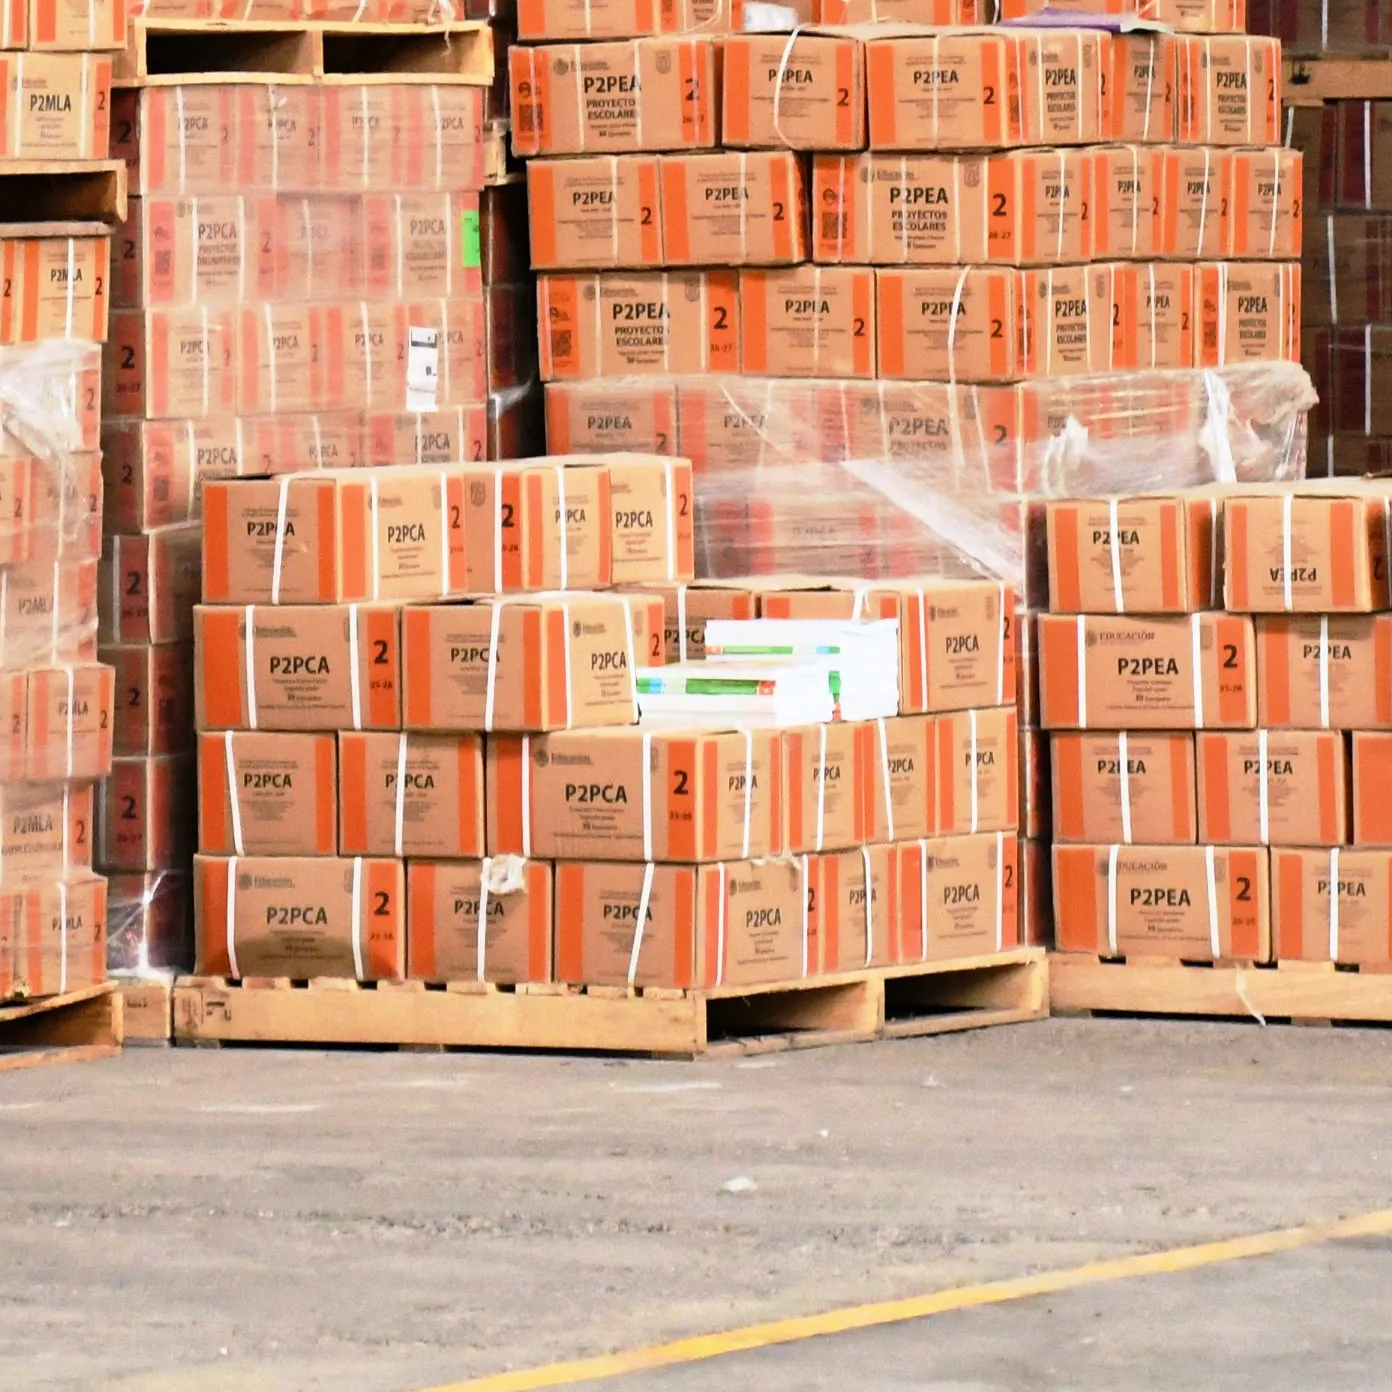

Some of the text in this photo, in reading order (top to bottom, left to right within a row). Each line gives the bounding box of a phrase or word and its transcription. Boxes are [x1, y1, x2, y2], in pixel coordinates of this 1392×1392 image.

[1045, 69, 1076, 85] P2PEA
[1217, 72, 1246, 89] P2PEA
[30, 94, 71, 111] P2MLA
[587, 99, 635, 108] PROYECTO
[838, 88, 849, 106] 2
[984, 86, 994, 104] 2
[588, 110, 635, 120] ESCOLARE
[117, 120, 131, 143] 2
[993, 194, 1007, 216] 2
[199, 223, 236, 239] P2PCA
[95, 277, 102, 295] 2
[1055, 300, 1087, 317] P2PEA
[1238, 297, 1267, 313] P2PEA
[713, 307, 728, 329] 2
[615, 326, 664, 335] PROYECTO
[854, 319, 865, 336] 2
[991, 319, 1002, 338] 2
[616, 337, 663, 346] ESCOLARE
[121, 346, 135, 369] 2
[588, 416, 632, 429] P2PEA
[198, 448, 236, 464] P2PCA
[502, 504, 514, 527] 2
[615, 511, 653, 528] P2PCA
[387, 524, 425, 543] P2PCA
[127, 572, 141, 595] 2
[374, 640, 388, 664] 2
[946, 635, 979, 653] P2PCA
[270, 656, 330, 674] P2PCA
[591, 652, 626, 670] P2PCA
[1224, 645, 1238, 668] 2
[1118, 658, 1179, 675] P2PEA
[244, 773, 292, 789] P2PCA
[674, 770, 688, 795] 2
[565, 784, 627, 803] P2PCA
[122, 796, 136, 820] 2
[944, 884, 980, 904] P2PCA
[1130, 888, 1190, 906] P2PEA
[1236, 877, 1251, 901] 2
[374, 892, 390, 915] 2
[266, 907, 327, 925] P2PCA
[746, 908, 781, 927] P2PCA
